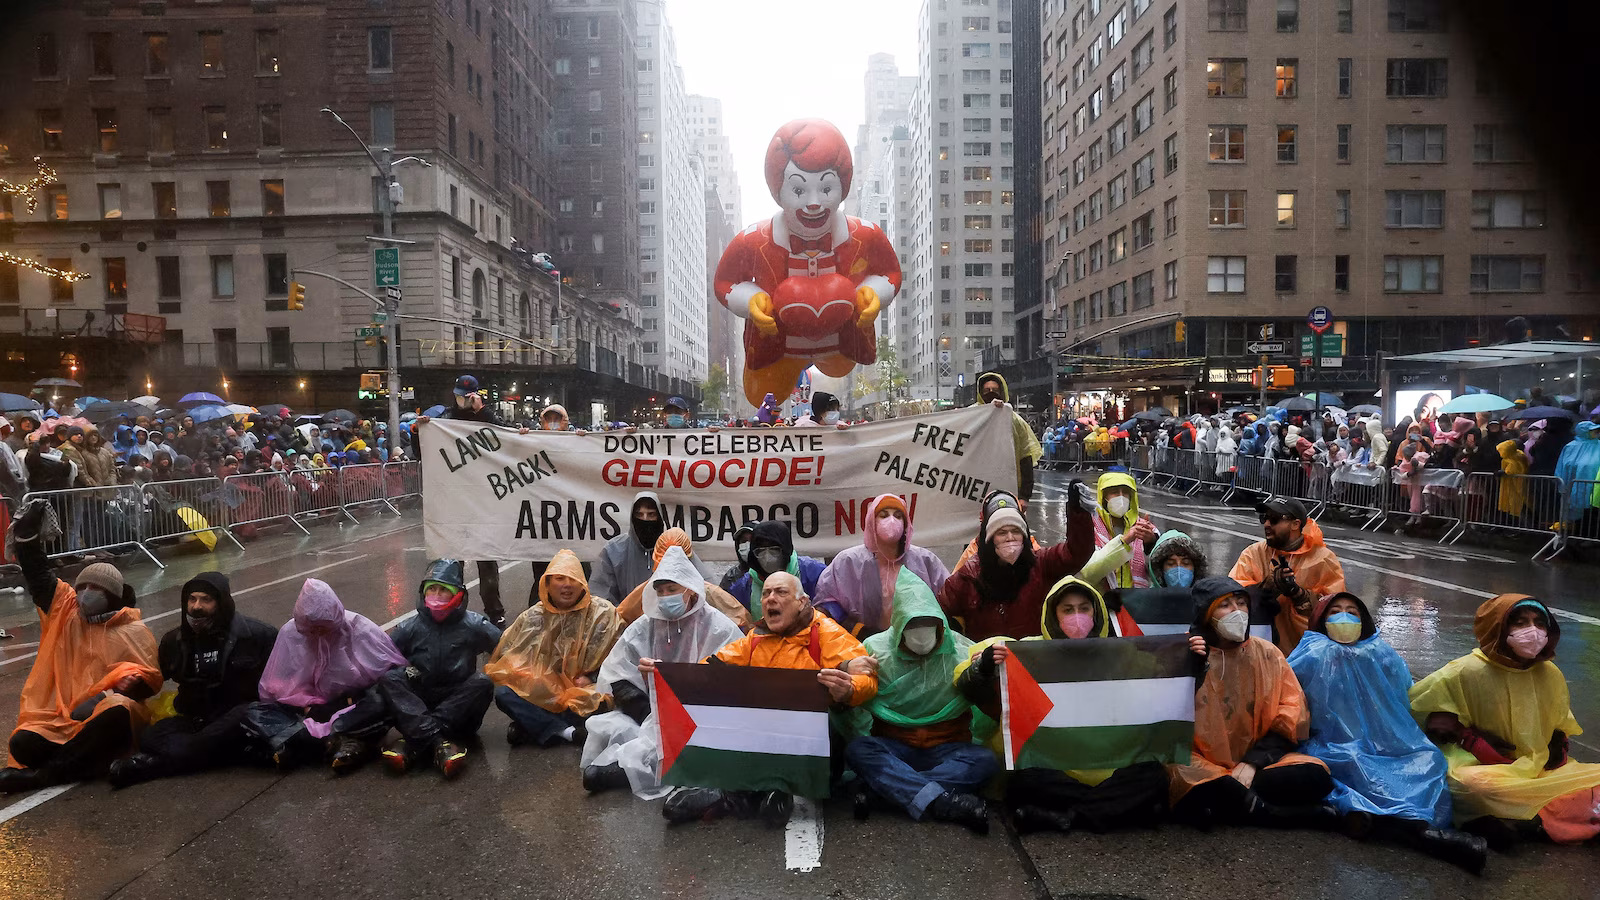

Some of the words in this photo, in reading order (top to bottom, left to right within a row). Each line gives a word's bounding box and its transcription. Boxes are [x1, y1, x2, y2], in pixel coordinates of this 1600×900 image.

[439, 427, 502, 473] LAND
[604, 435, 677, 456] DON'T
[684, 434, 824, 456] CELEBRATE
[911, 422, 971, 457] FREE
[486, 450, 558, 500] BACK!
[601, 455, 826, 489] GENOCIDE!
[874, 451, 991, 504] PALESTINE!
[515, 500, 621, 541] ARMS
[660, 502, 820, 542] MBARGO
